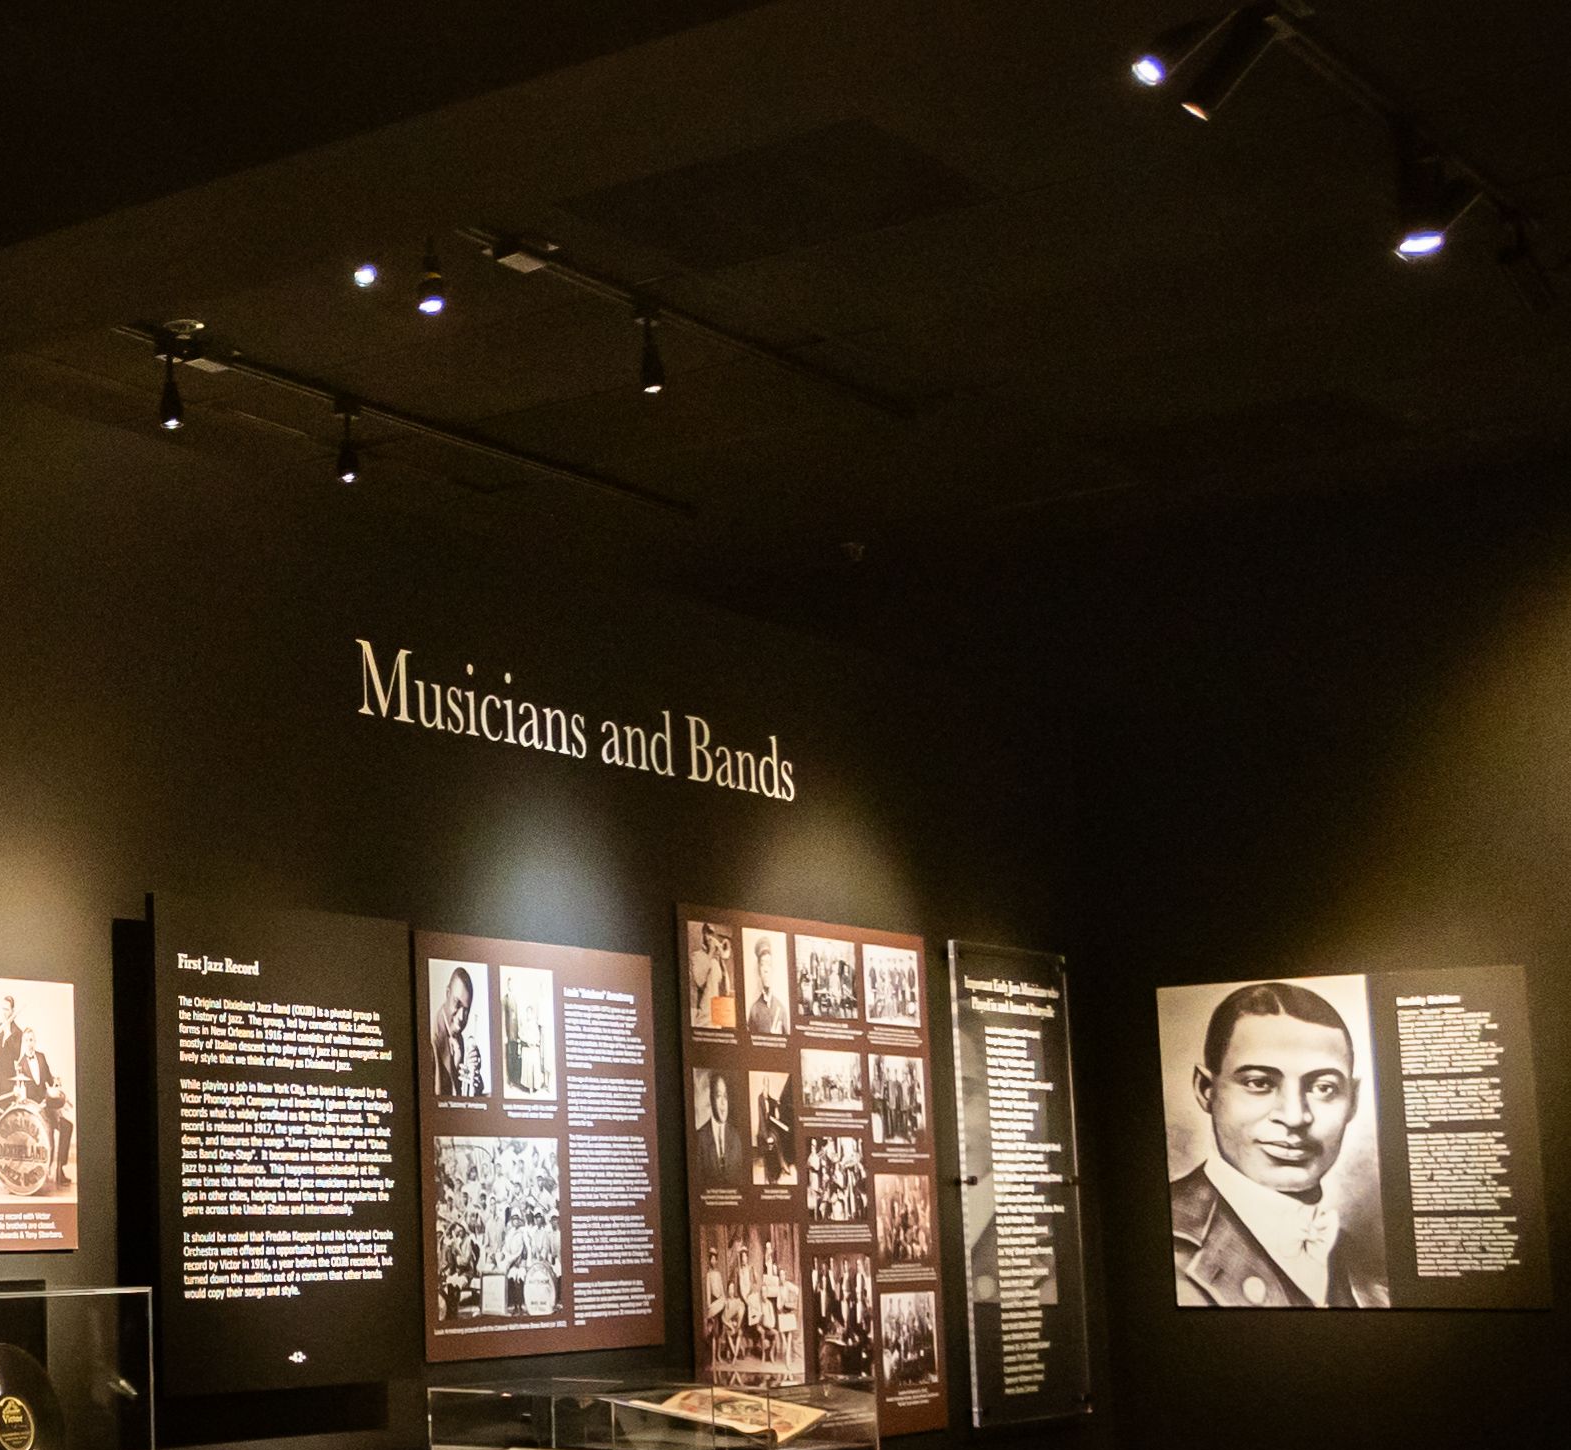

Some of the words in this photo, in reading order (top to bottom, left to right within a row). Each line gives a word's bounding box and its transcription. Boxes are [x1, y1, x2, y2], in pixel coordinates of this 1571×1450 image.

[356, 638, 587, 759] Musicians
[601, 710, 674, 777] and
[684, 715, 796, 802] Bands
[177, 953, 202, 970] First
[201, 955, 224, 975] Jazz
[224, 957, 260, 976] Record
[178, 994, 192, 1006] The
[193, 995, 221, 1011] Original
[257, 1001, 271, 1013] Jazz
[272, 1002, 290, 1014] Band
[191, 1231, 215, 1242] should
[227, 1231, 248, 1242] noted
[249, 1231, 264, 1241] that
[265, 1230, 291, 1241] Freddie
[320, 1230, 334, 1241] and
[334, 1230, 345, 1241] his
[183, 1259, 207, 1270] record
[219, 1258, 239, 1270] Victor
[251, 1257, 271, 1271] 1916,
[278, 1259, 293, 1271] year
